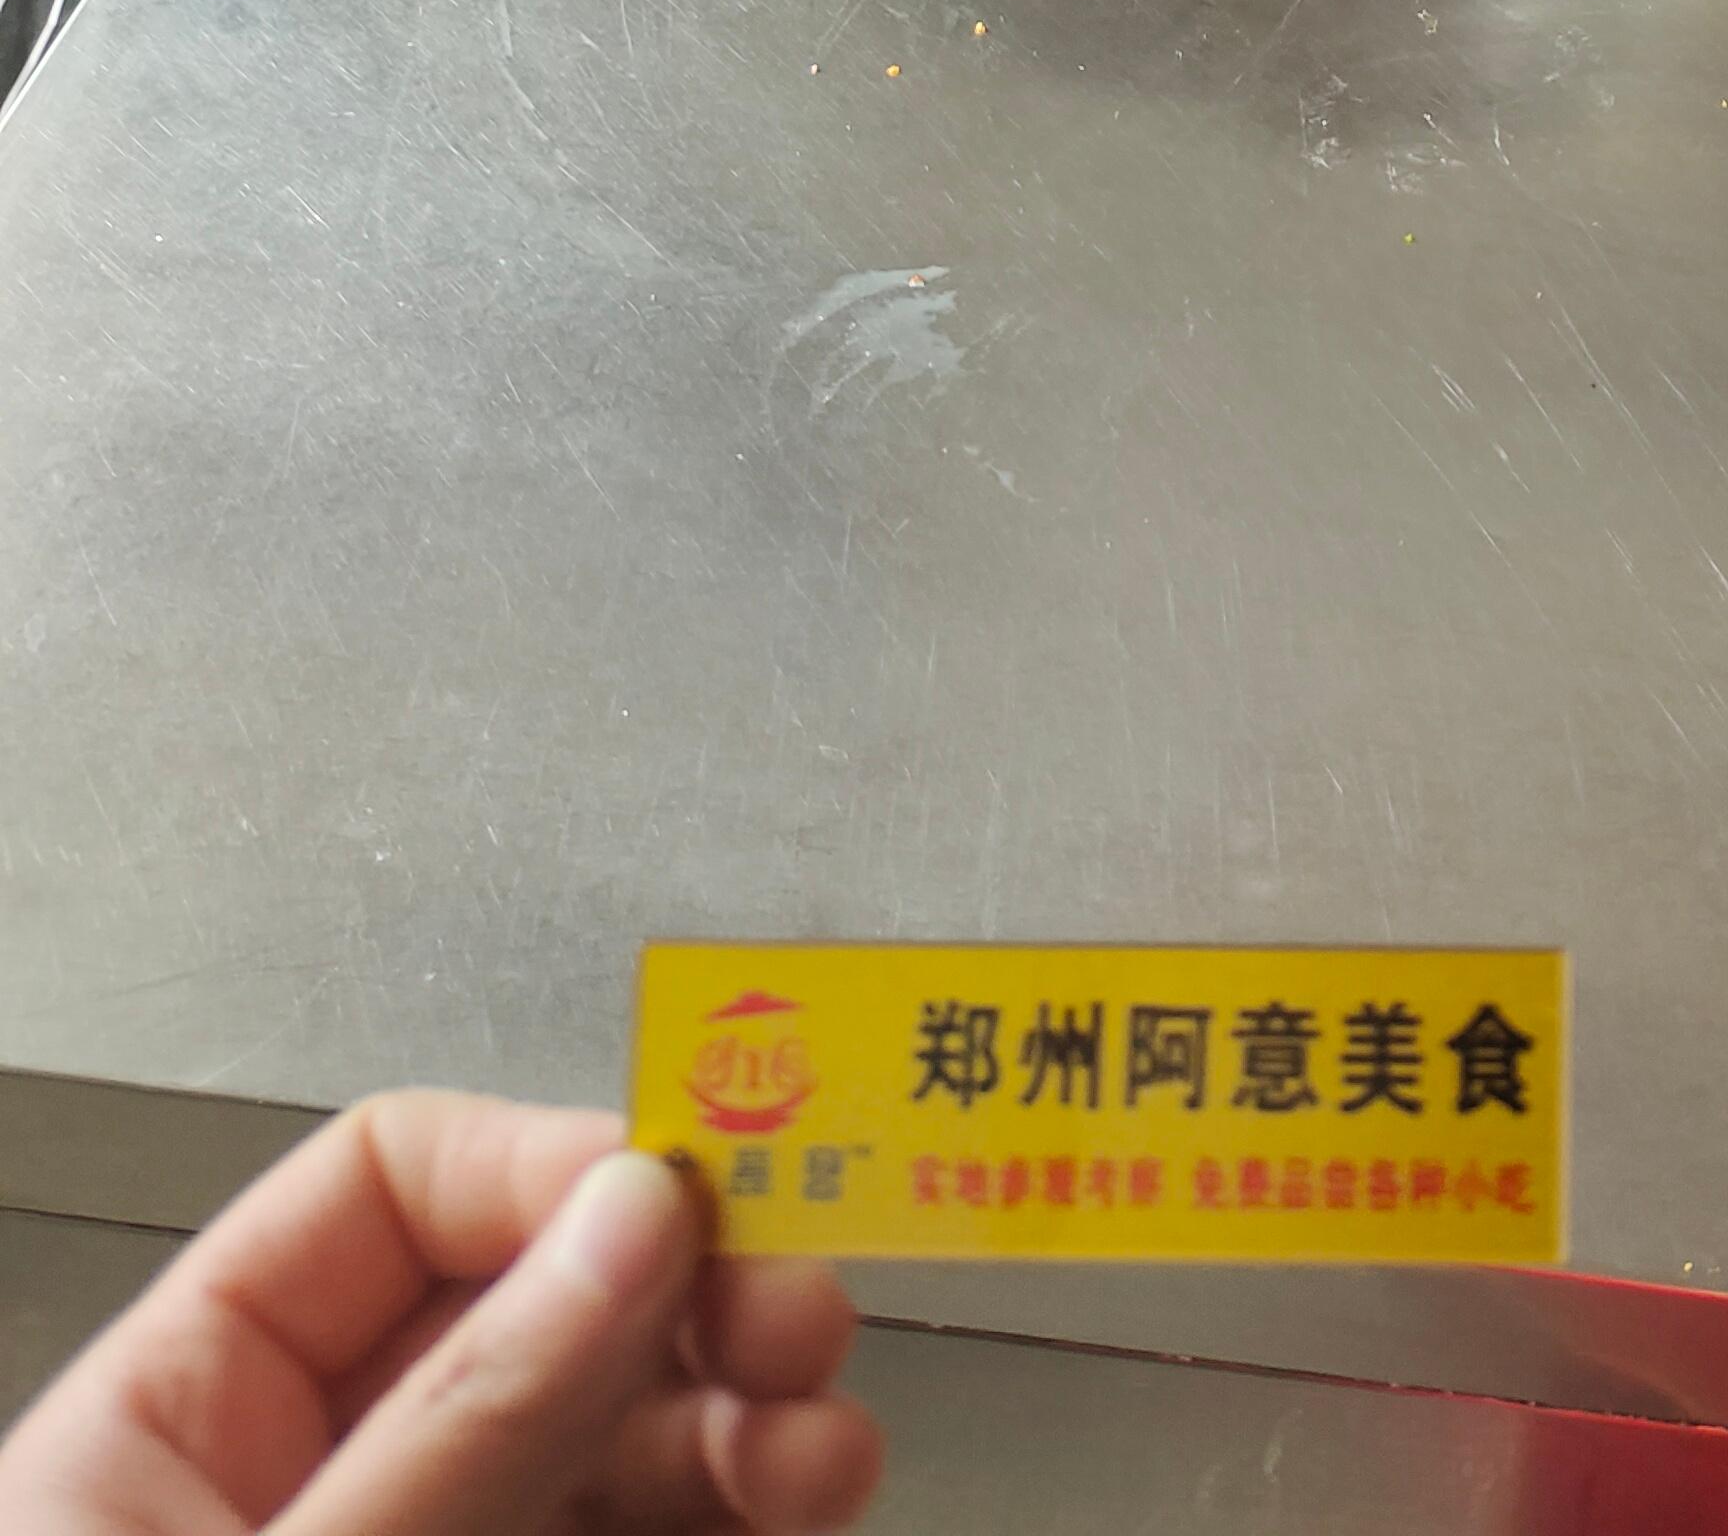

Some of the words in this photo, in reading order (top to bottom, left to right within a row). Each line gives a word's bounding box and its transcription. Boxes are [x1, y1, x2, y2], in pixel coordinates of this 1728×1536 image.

[912, 1000, 1535, 1116] 郑州阿意美食
